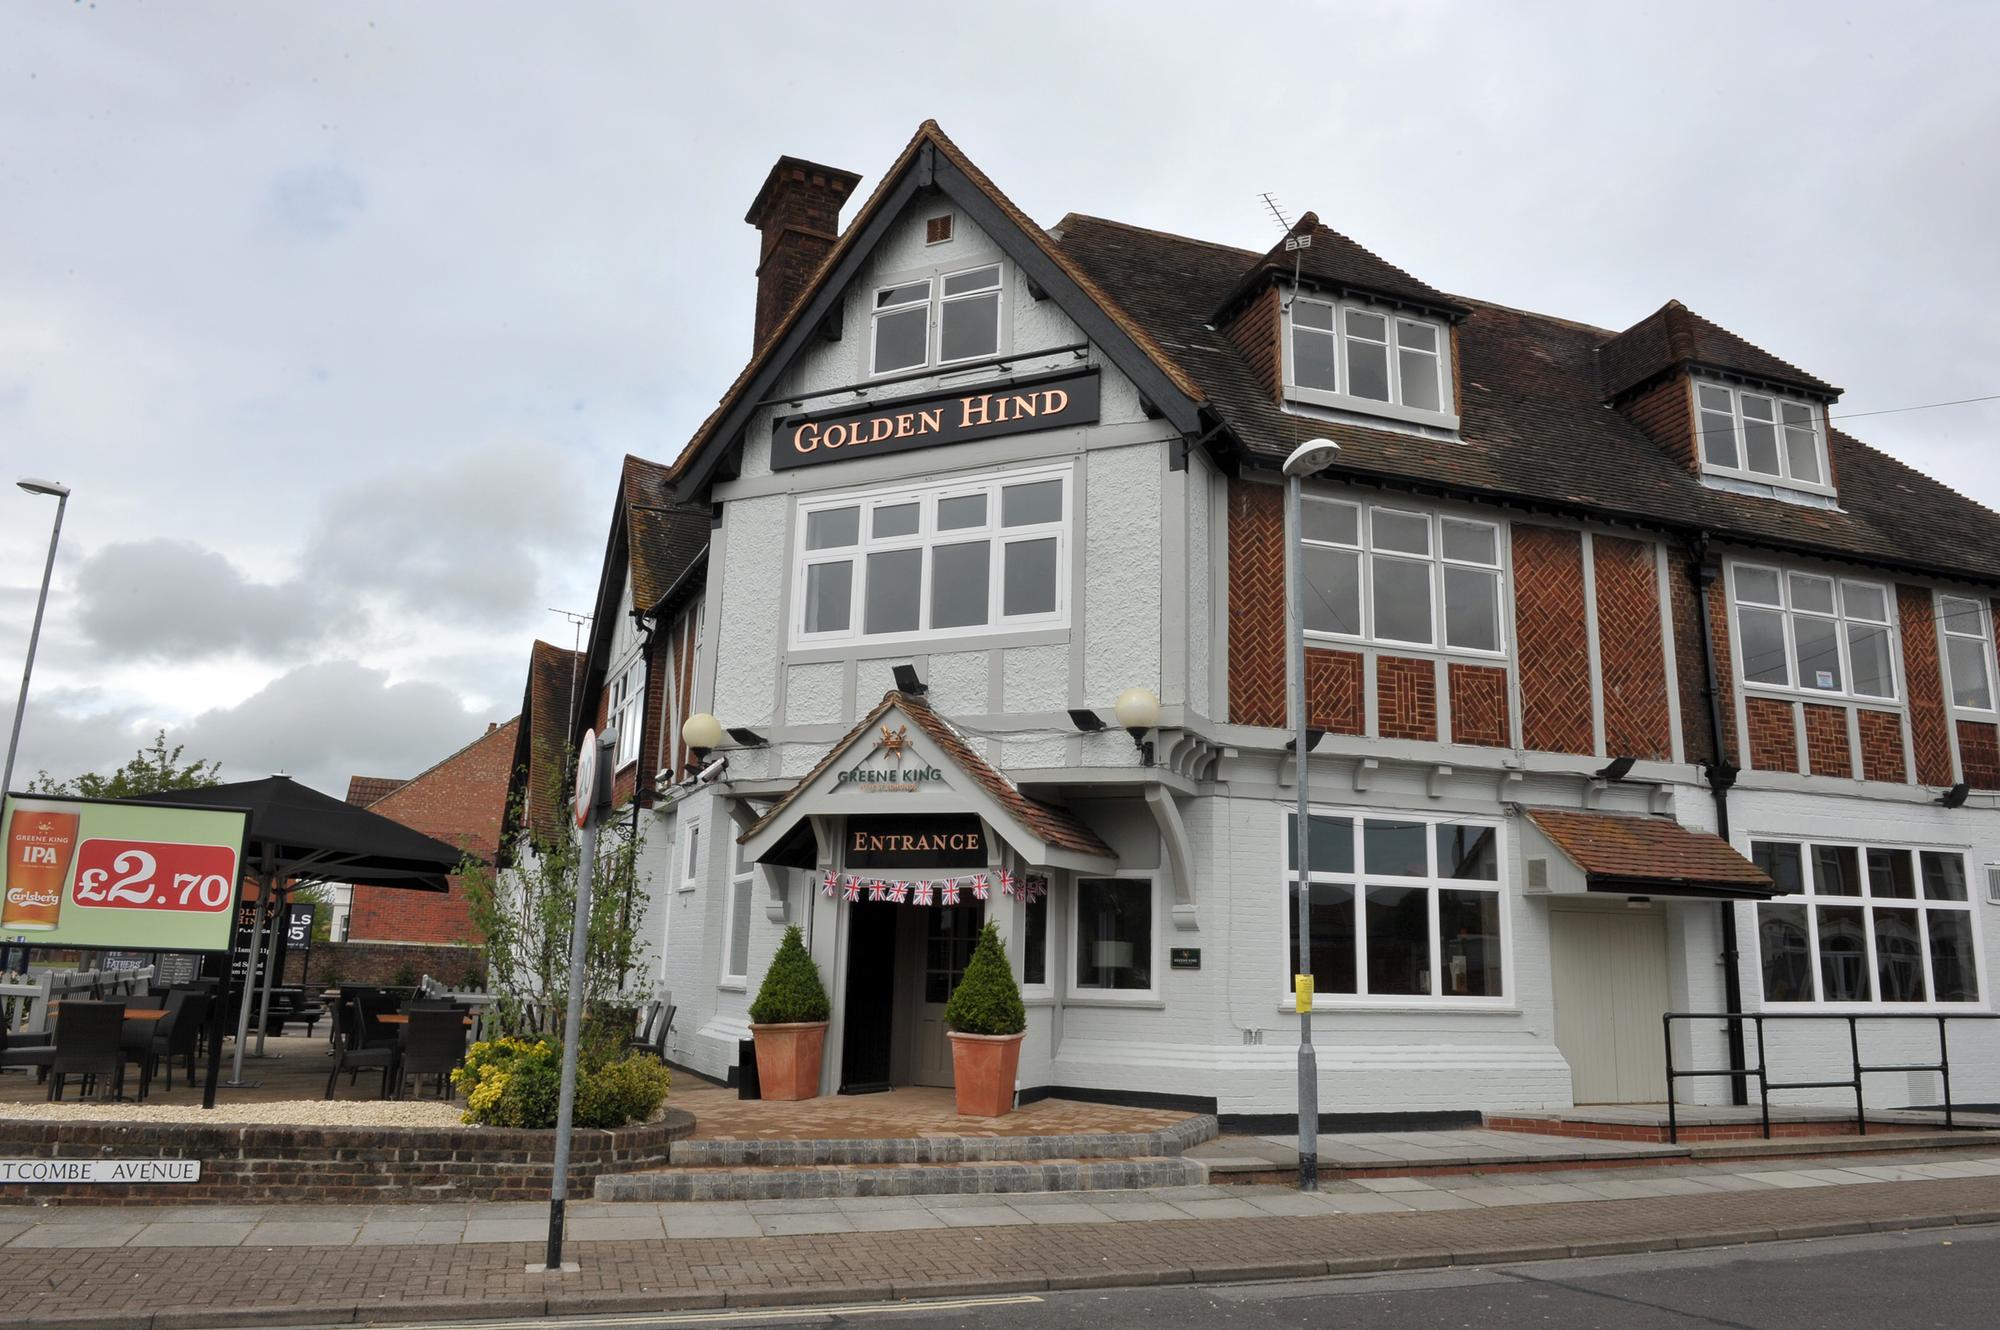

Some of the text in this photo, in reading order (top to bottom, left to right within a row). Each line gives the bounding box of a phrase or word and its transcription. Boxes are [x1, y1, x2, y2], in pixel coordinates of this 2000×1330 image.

[793, 388, 1069, 453] GOLDEN HIND
[838, 769, 942, 783] GREENE KING
[16, 834, 47, 843] GREENE
[853, 831, 979, 851] ENTRANCE
[22, 846, 57, 864] IPA
[77, 850, 229, 906] £2.70
[7, 888, 59, 906] Carlsberg
[112, 1163, 194, 1179] AVENUE
